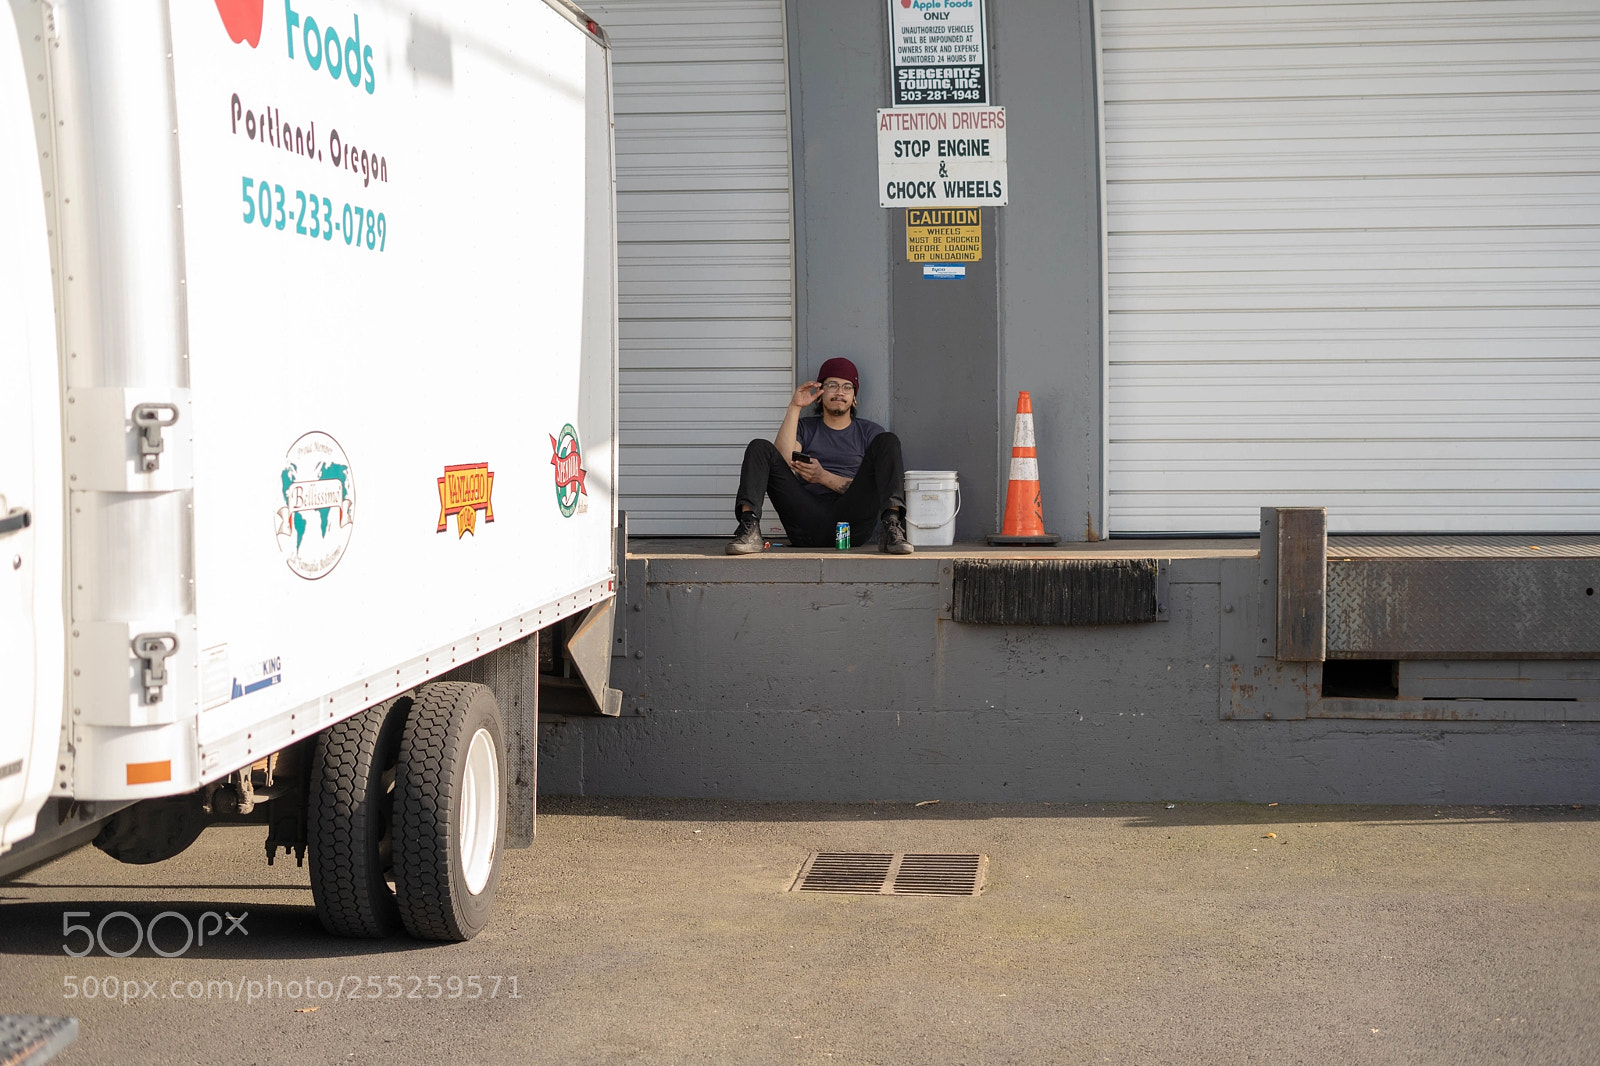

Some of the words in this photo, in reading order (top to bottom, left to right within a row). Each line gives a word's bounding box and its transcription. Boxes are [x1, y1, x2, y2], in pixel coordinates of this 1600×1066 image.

[913, 0, 941, 11] Apple
[945, 0, 973, 9] Foods
[924, 12, 950, 20] ONLY
[902, 26, 945, 34] UNAUTHORIZED
[948, 25, 974, 33] VEHICLES
[903, 36, 917, 44] WILL
[929, 35, 964, 43] IMPOUNDED
[285, 0, 375, 95] Foods
[898, 46, 922, 54] OWNERS
[925, 45, 938, 53] RISK
[940, 45, 952, 53] AND
[954, 44, 979, 52] EXPENSE
[902, 55, 935, 63] MONITORED
[947, 54, 966, 62] HOURS
[969, 54, 976, 62] BY
[898, 67, 981, 79] SERGEANTS
[900, 90, 980, 101] 503-281-1948
[880, 112, 947, 131] ATTENTION
[952, 111, 1005, 130] DRIVERS
[894, 139, 931, 158] STOP
[937, 139, 990, 157] ENGINE
[330, 129, 387, 188] Oregon
[939, 160, 949, 178] &
[886, 181, 937, 199] CHOCK
[943, 180, 1002, 198] WHEELS
[242, 176, 386, 252] 503-233-0789
[909, 210, 977, 225] CAUTION
[930, 252, 975, 260] UNLOADING
[263, 656, 281, 675] KING
